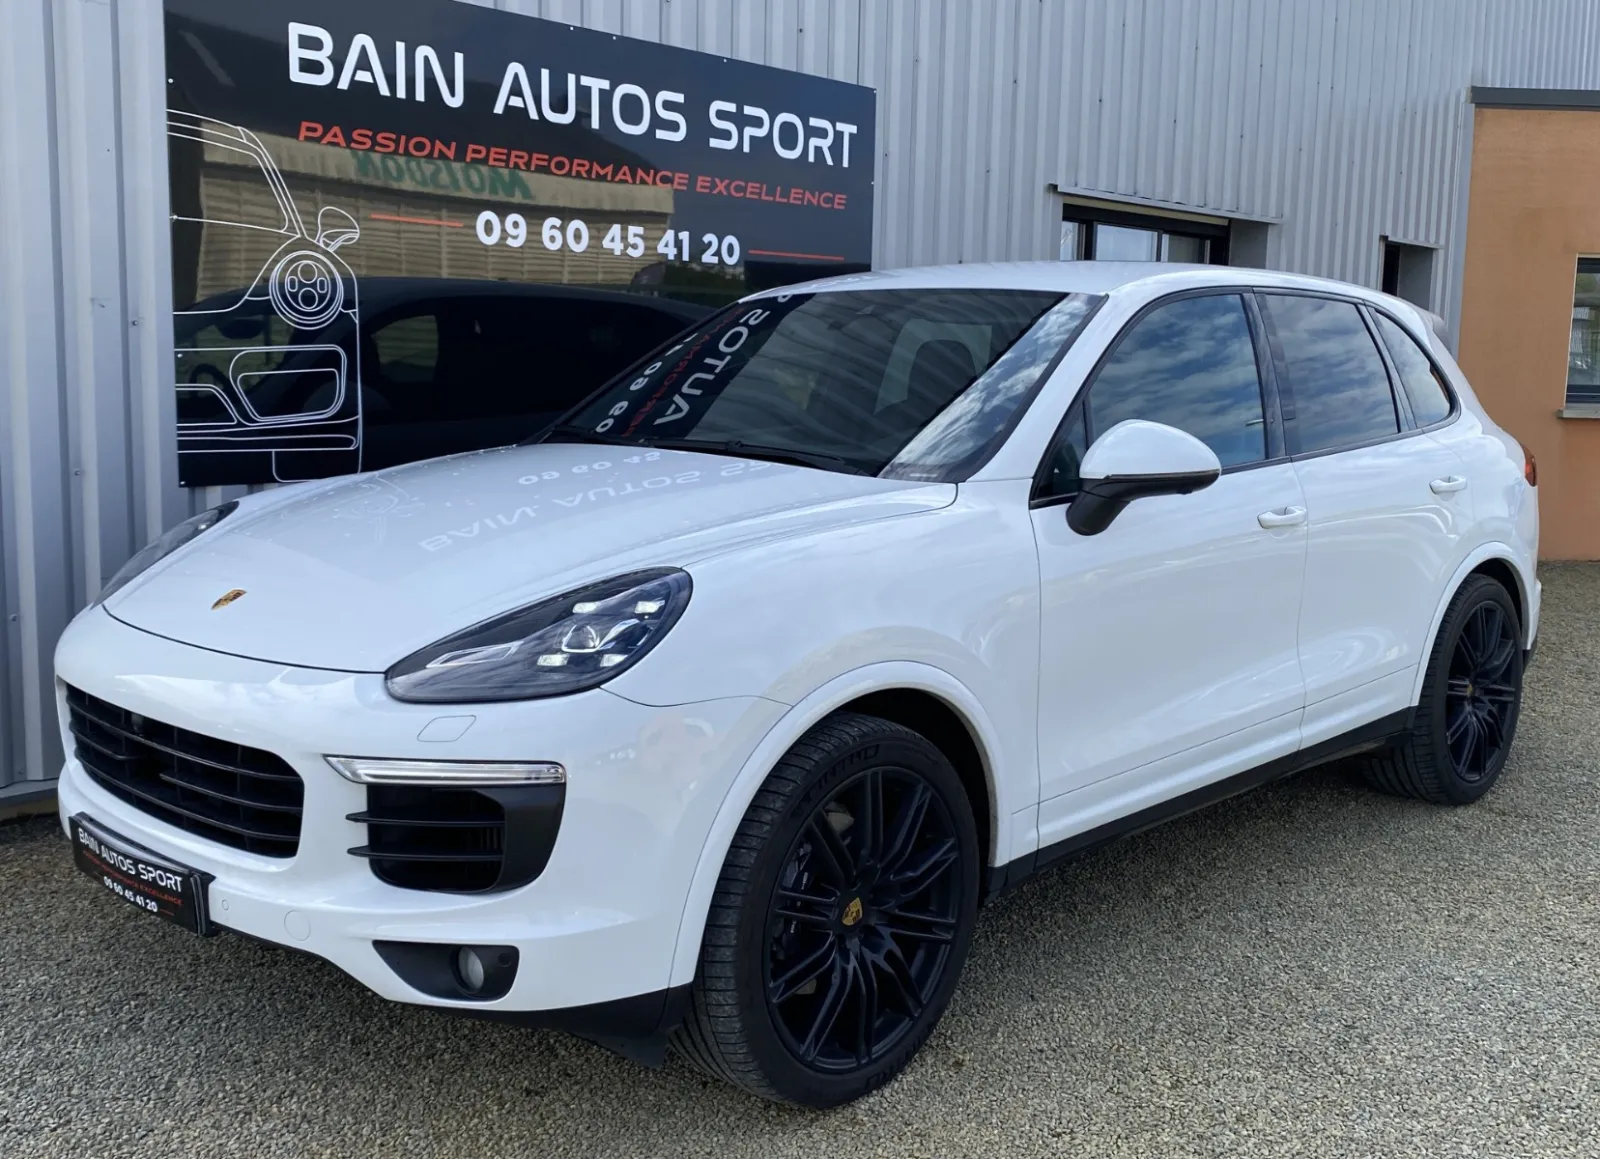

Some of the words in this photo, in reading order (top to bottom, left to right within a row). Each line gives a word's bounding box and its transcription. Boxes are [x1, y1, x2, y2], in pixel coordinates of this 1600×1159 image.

[288, 21, 464, 108] BAIN
[493, 61, 687, 142] AUTOS
[708, 100, 858, 168] SPORT
[298, 121, 456, 159] PASSION
[466, 144, 688, 191] PERFORMANCE
[696, 175, 847, 210] EXCELLENCE
[475, 210, 528, 248] 09
[541, 216, 590, 253] 60
[601, 223, 646, 258] 45
[656, 229, 690, 262] 41
[701, 233, 740, 266] 20
[78, 827, 100, 854] BAIN
[101, 845, 136, 875] AUTOS
[137, 863, 183, 893] SPORT
[124, 889, 135, 902] 45
[135, 895, 145, 907] 41
[145, 899, 158, 913] 20
